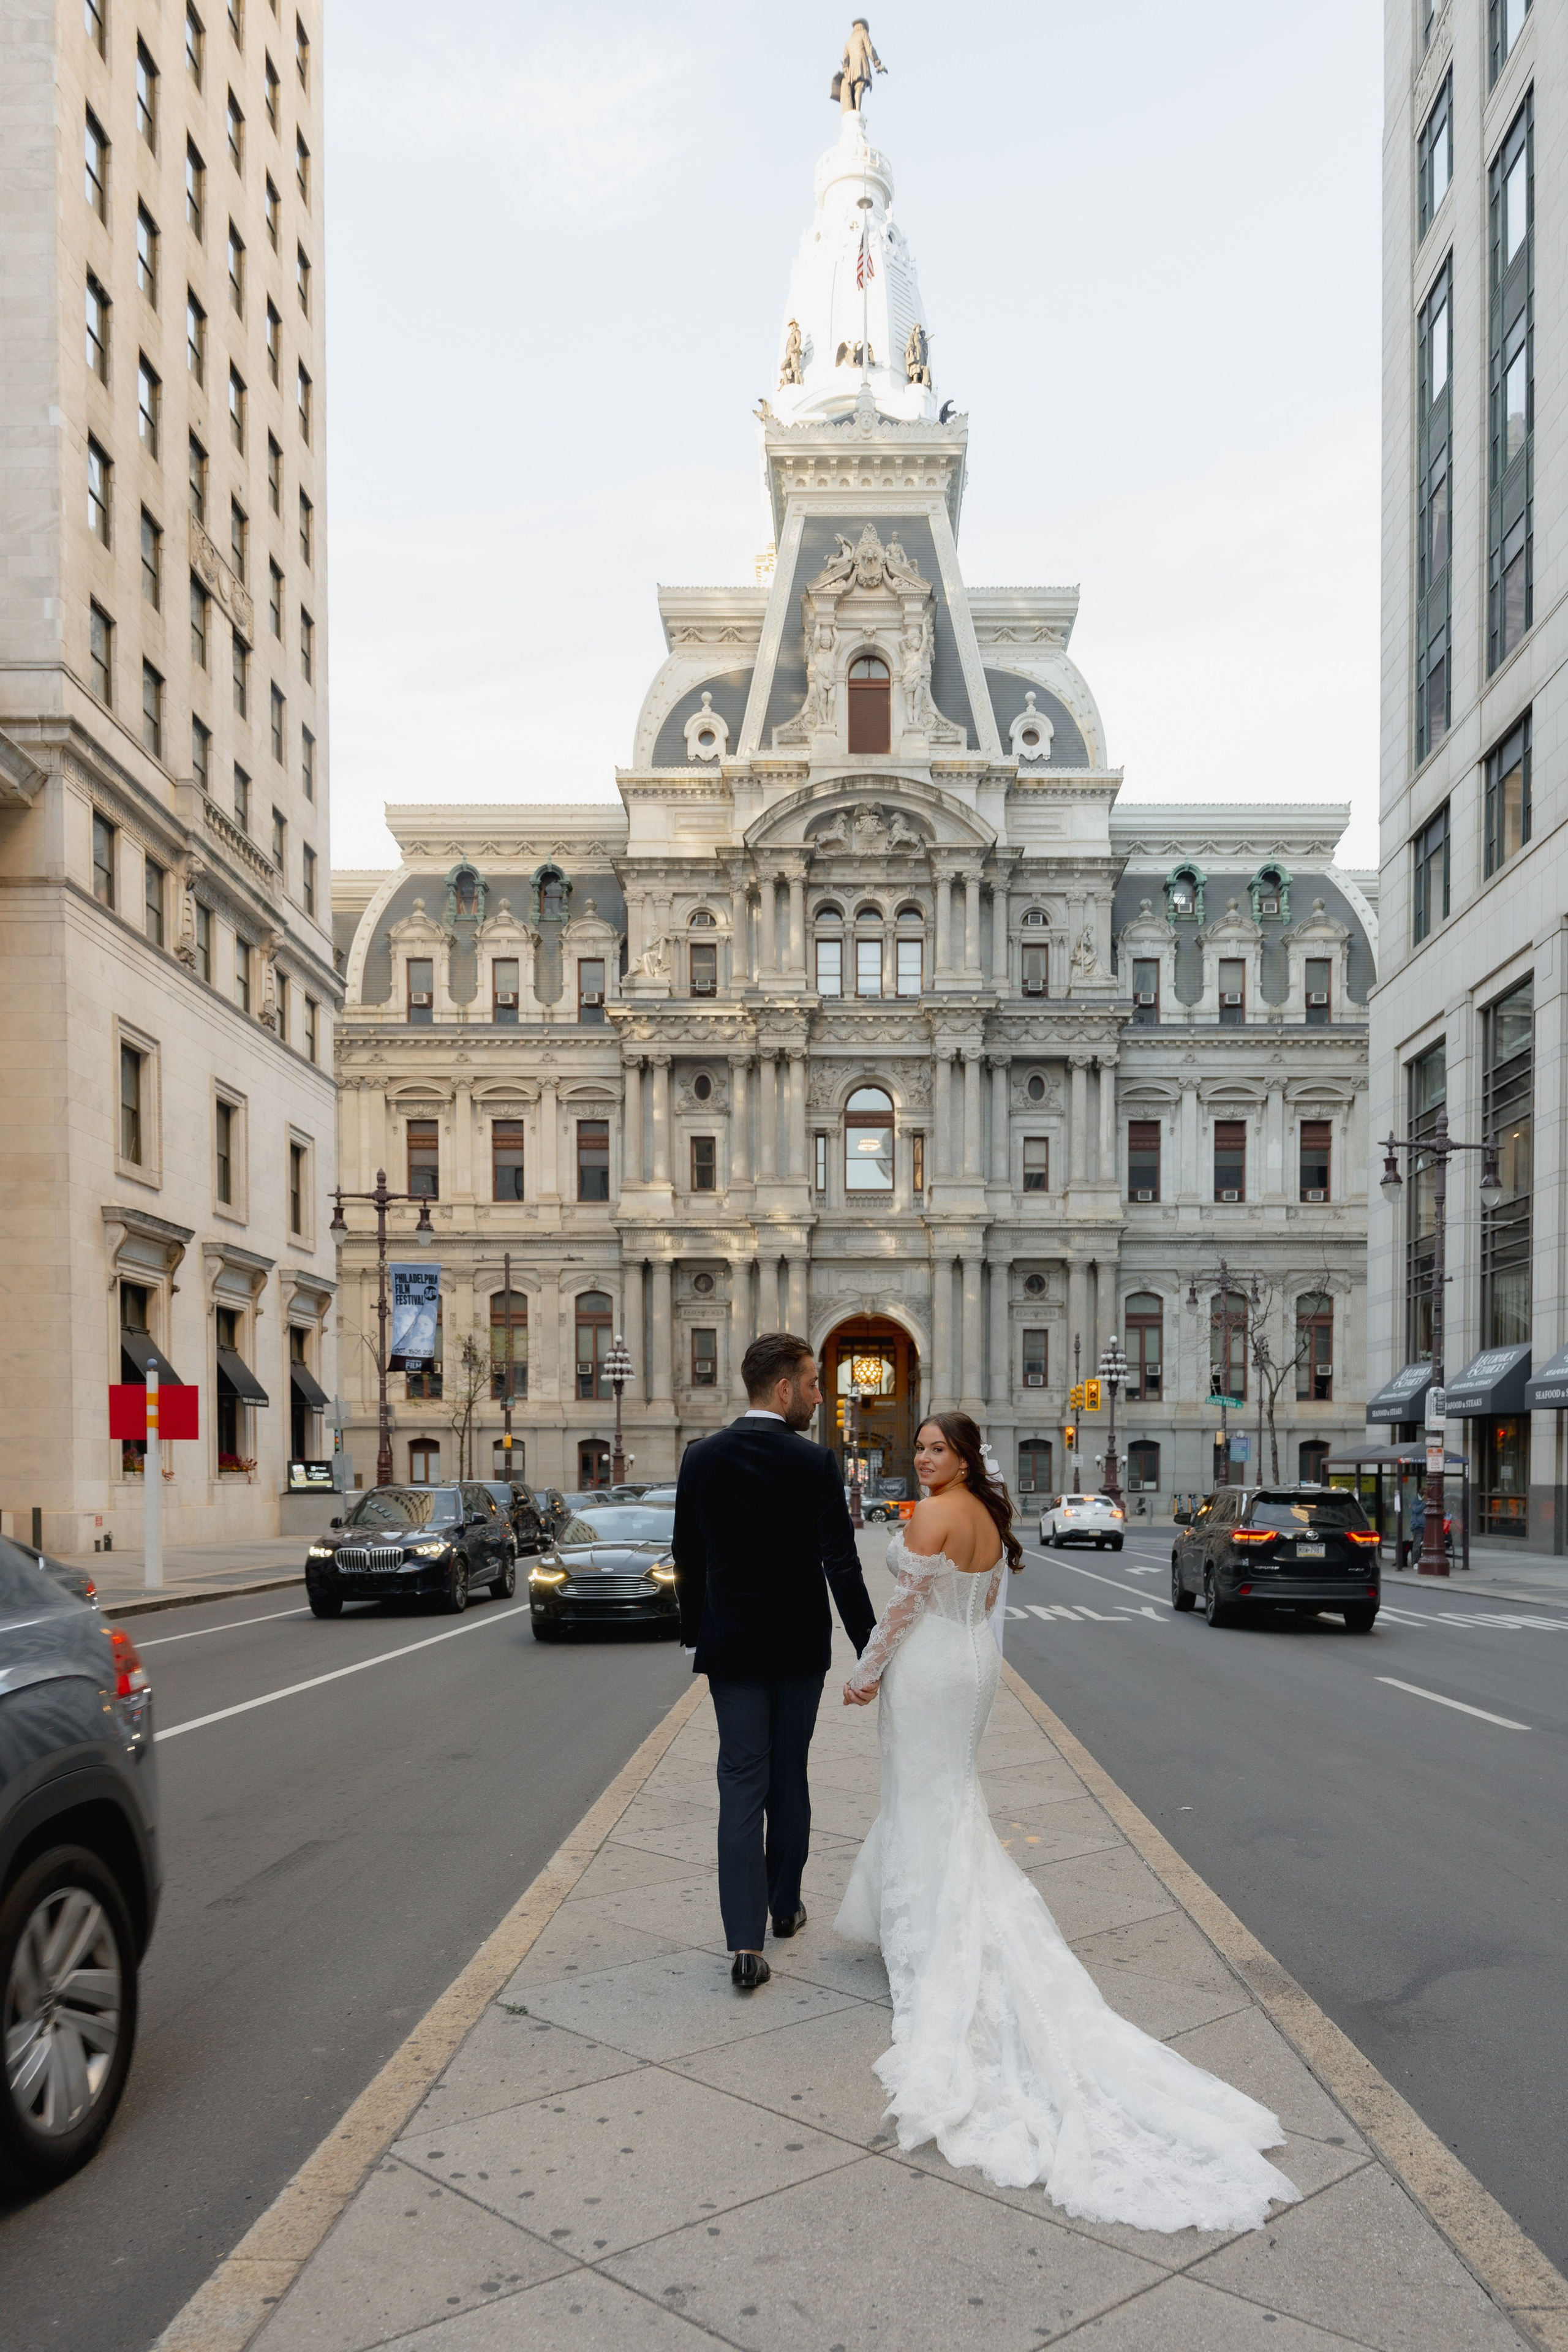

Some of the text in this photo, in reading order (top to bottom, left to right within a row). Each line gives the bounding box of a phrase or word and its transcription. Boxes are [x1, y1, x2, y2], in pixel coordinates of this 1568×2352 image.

[394, 1273, 438, 1284] PHILADELPHIA
[395, 1284, 410, 1294] FILM
[396, 1295, 424, 1305] FESTIVAL
[1535, 1389, 1561, 1400] SEAFOOD
[1206, 1397, 1222, 1406] SOUTH
[1446, 1400, 1462, 1411] EAFOOD
[1466, 1398, 1482, 1408] STEAKS
[1372, 1409, 1387, 1417] SEAFOOD
[1390, 1407, 1403, 1415] STEAKS
